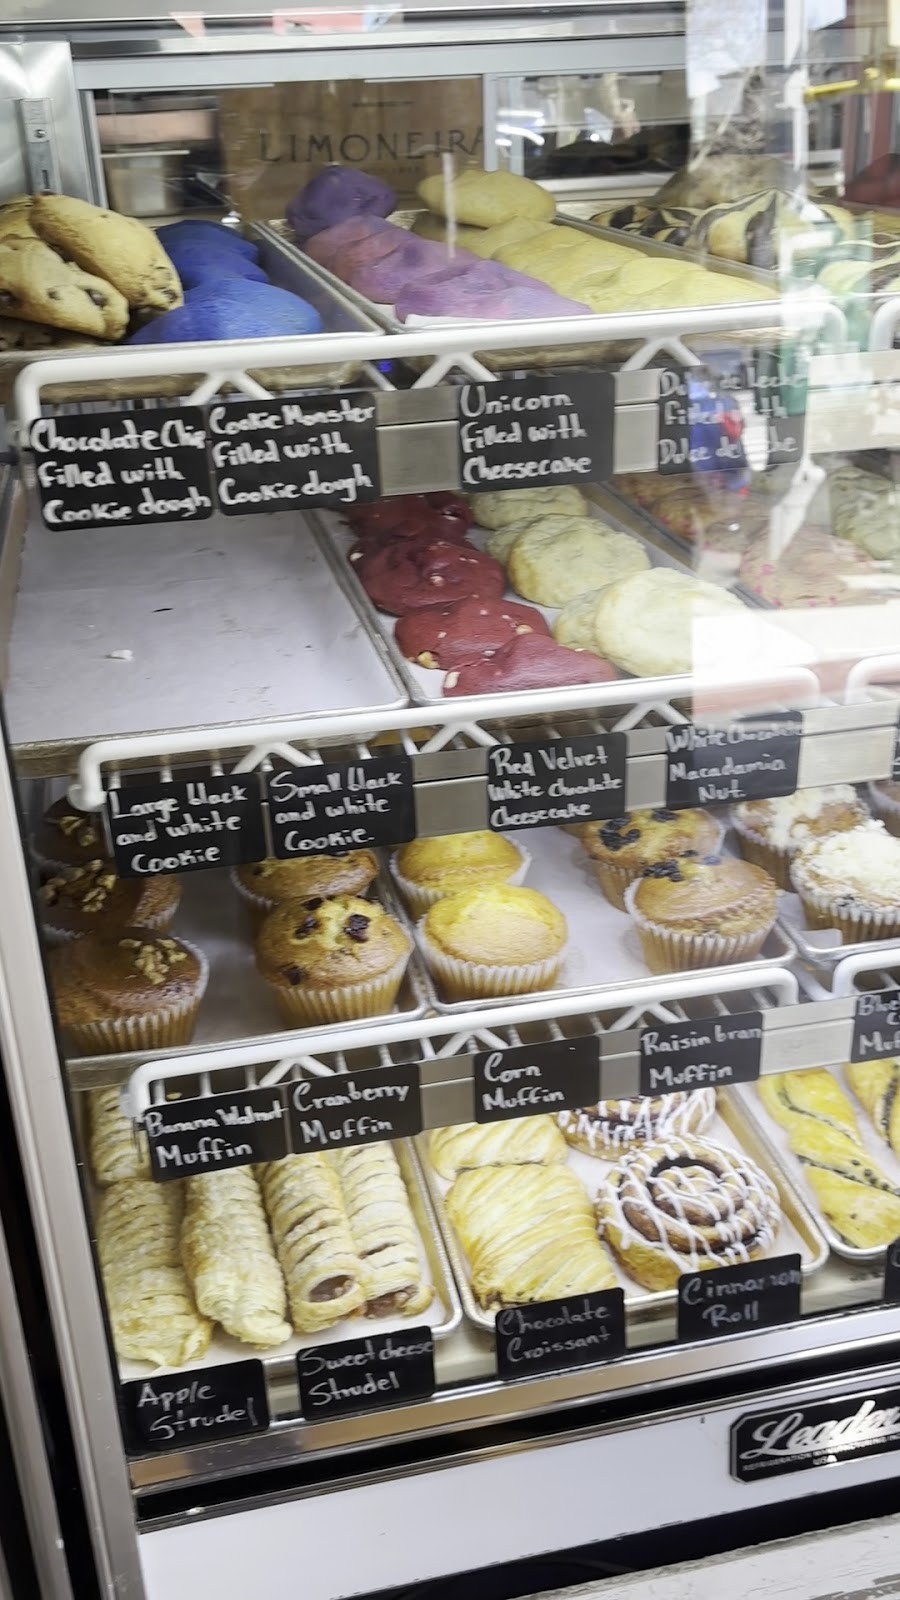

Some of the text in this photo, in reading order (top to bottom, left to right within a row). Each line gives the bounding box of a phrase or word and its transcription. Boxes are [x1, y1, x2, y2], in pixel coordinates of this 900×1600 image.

[460, 384, 575, 418] Unicorn
[209, 399, 375, 436] Cookie Monster
[527, 413, 587, 441] with
[30, 418, 163, 453] Chocolate
[283, 431, 353, 459] with
[658, 438, 713, 465] Dulce
[715, 435, 743, 459] de
[120, 456, 186, 482] with
[217, 463, 374, 506] Cookie dough
[463, 454, 593, 485] Cheesecake
[42, 486, 212, 524] Cookie dough
[665, 725, 728, 753] White
[489, 745, 609, 777] Red Velvet
[669, 755, 787, 781] Macadamia
[269, 766, 403, 803] Small black
[487, 773, 624, 802] White Chocolate
[698, 778, 747, 803] Nut
[109, 782, 250, 824] Large black
[274, 793, 391, 824] and white
[490, 803, 593, 828] Cheesecake
[115, 810, 242, 847] and white
[130, 845, 221, 873] Cookie
[858, 992, 900, 1016] Blue
[641, 1024, 763, 1056] Raisin bran
[484, 1052, 542, 1083] Corn
[649, 1065, 734, 1089] Muffin
[293, 1081, 410, 1112] Cranberry
[483, 1089, 565, 1113] Muffin
[144, 1099, 289, 1138] Banana Walnut
[300, 1116, 393, 1145] Muffin
[156, 1136, 253, 1169] Muffin
[500, 1299, 610, 1336] Chocolate
[702, 1300, 759, 1328] Roll
[298, 1339, 376, 1377] Sweet
[506, 1325, 612, 1362] Croissant
[137, 1380, 216, 1412] Apple
[308, 1371, 400, 1406] Strudel
[149, 1397, 258, 1441] Strudel
[739, 1399, 900, 1460] Leader
